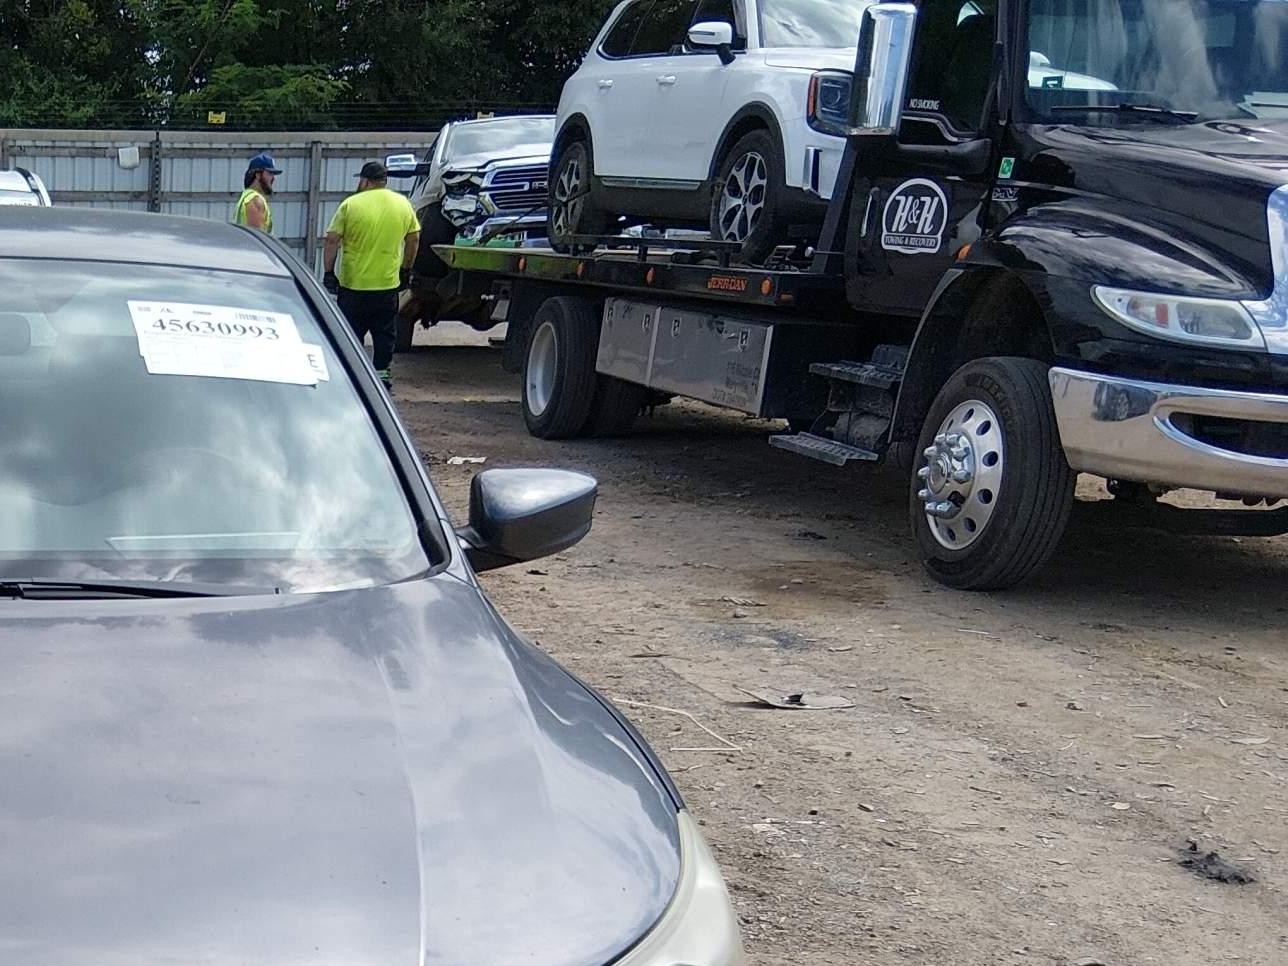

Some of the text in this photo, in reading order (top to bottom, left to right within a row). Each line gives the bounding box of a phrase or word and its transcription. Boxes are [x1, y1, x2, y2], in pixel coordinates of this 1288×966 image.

[909, 98, 940, 111] NO SMOKING
[892, 195, 939, 234] H&H
[885, 236, 904, 245] TOWING
[909, 237, 936, 247] RECOVERY
[152, 318, 279, 340] 45630993
